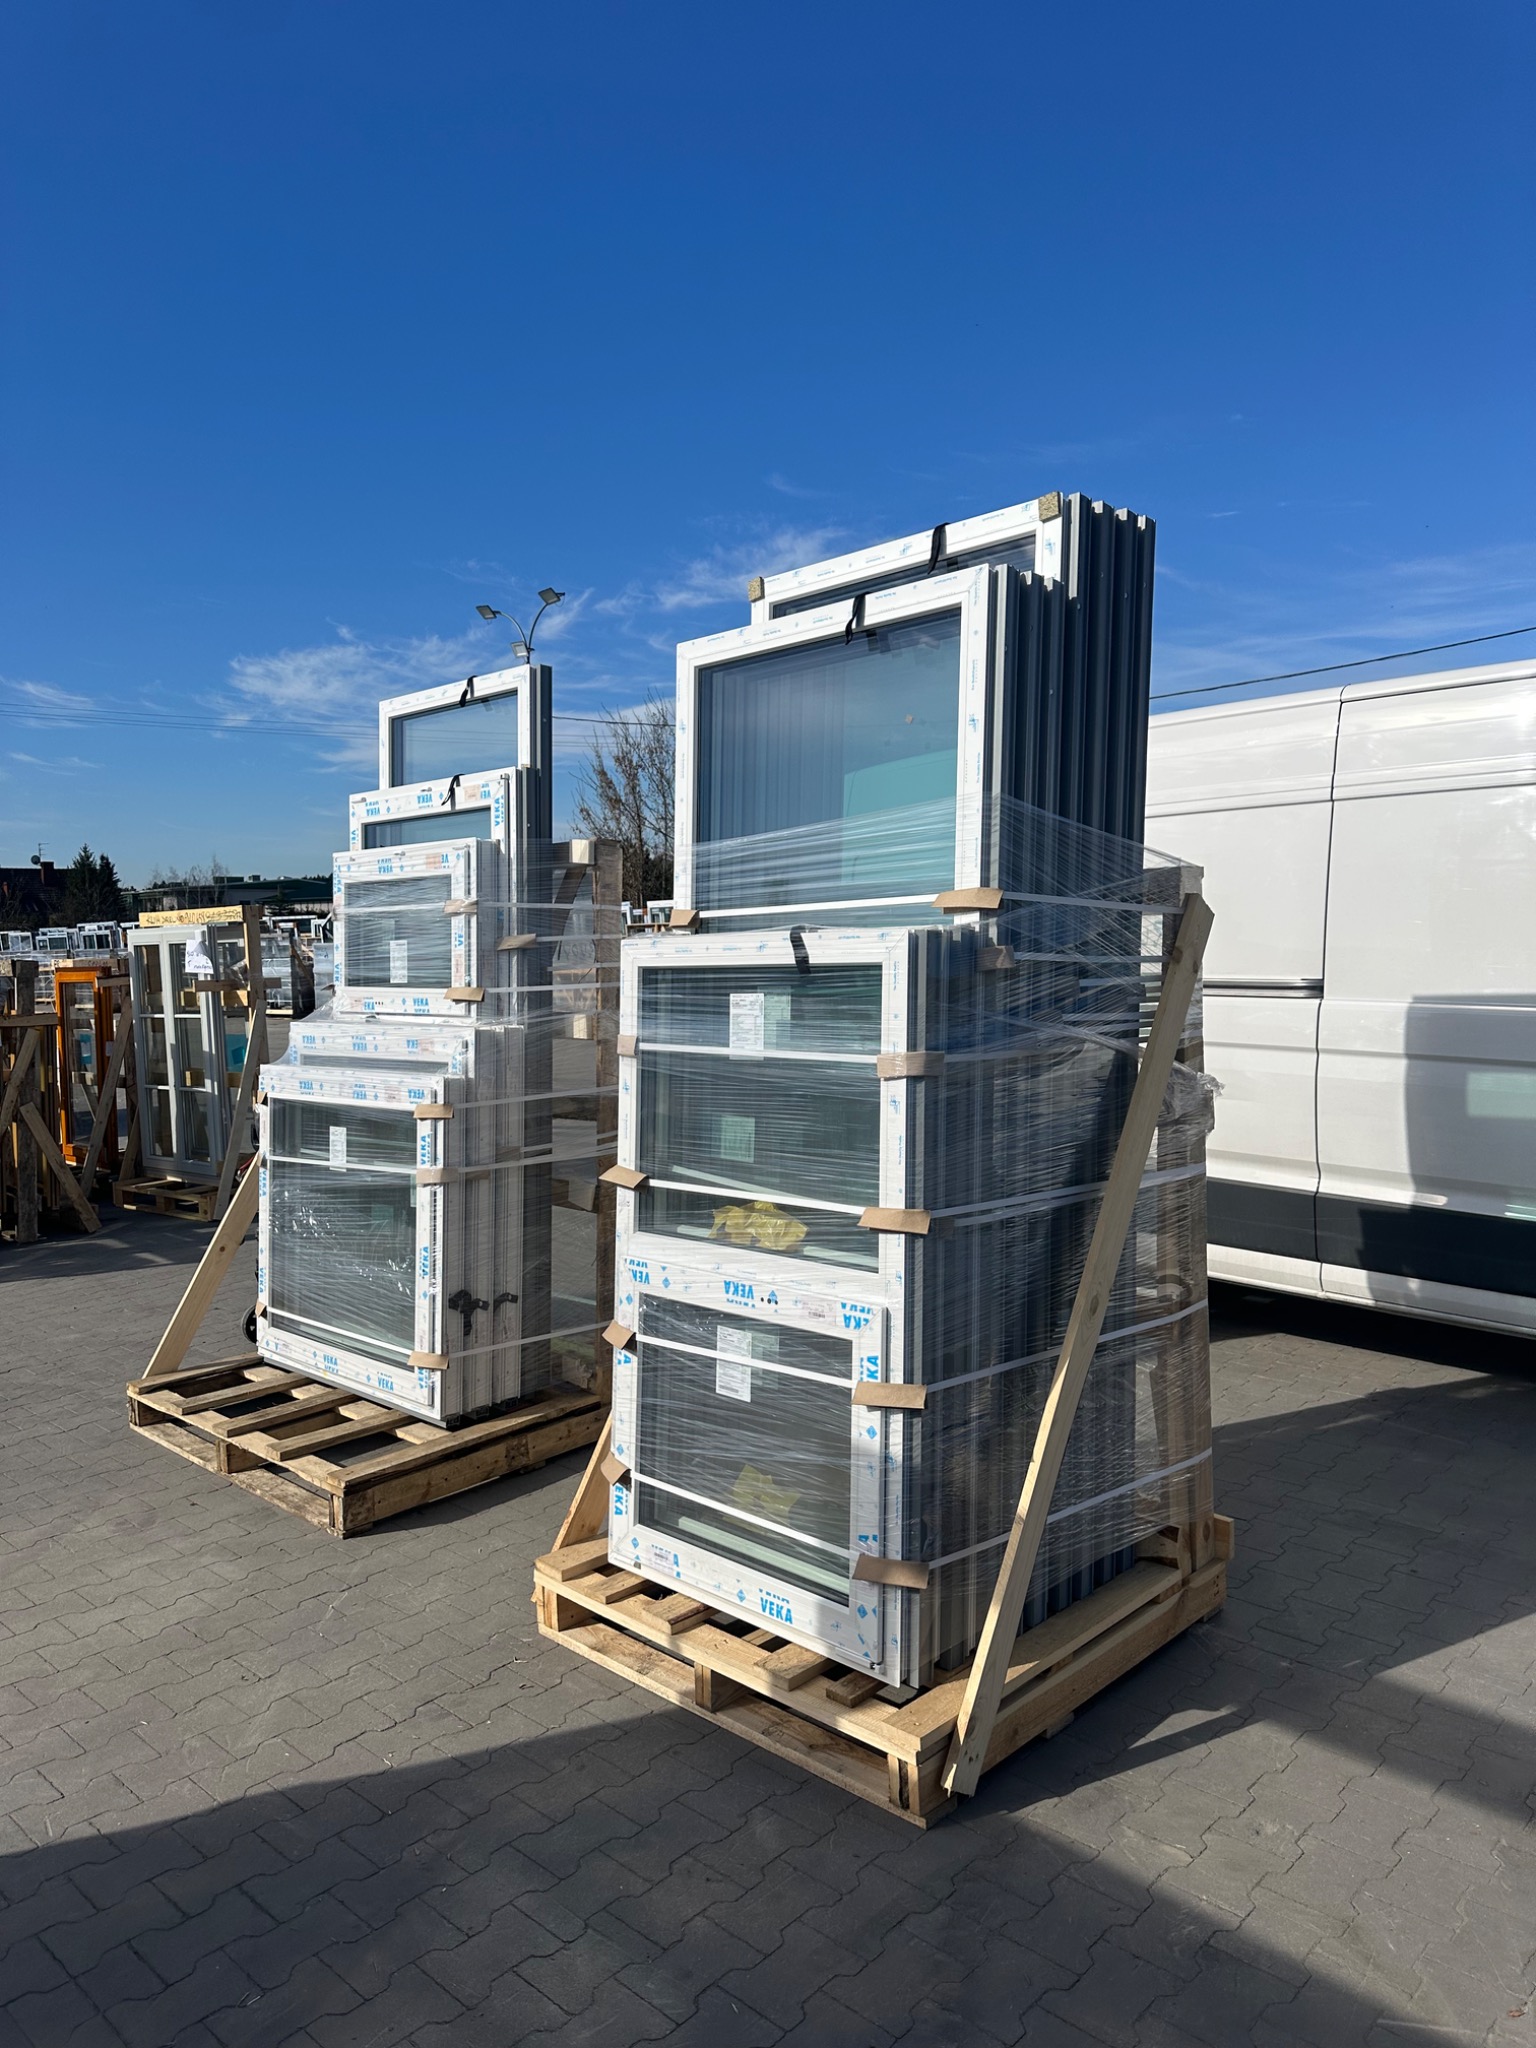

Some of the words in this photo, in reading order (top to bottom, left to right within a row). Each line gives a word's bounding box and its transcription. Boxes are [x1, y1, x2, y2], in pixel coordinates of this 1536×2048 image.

[417, 793, 433, 804] VEKA
[480, 789, 491, 800] VE
[366, 806, 381, 817] VEKA
[441, 853, 449, 864] VE
[378, 865, 393, 874] VEKA
[364, 1001, 375, 1011] EKA
[413, 997, 429, 1007] VEKA
[302, 1036, 316, 1044] VEKA
[406, 1040, 418, 1049] EKA
[352, 1042, 367, 1051] VEKA
[299, 1080, 313, 1090] VEKA
[408, 1088, 425, 1099] VEKA
[723, 1280, 755, 1300] VEKA
[843, 1313, 869, 1330] EKA
[323, 1353, 338, 1366] VEKA
[866, 1355, 879, 1381] KA
[377, 1377, 393, 1391] VEKA
[614, 1484, 623, 1515] EKA
[760, 1597, 794, 1625] VEKA
